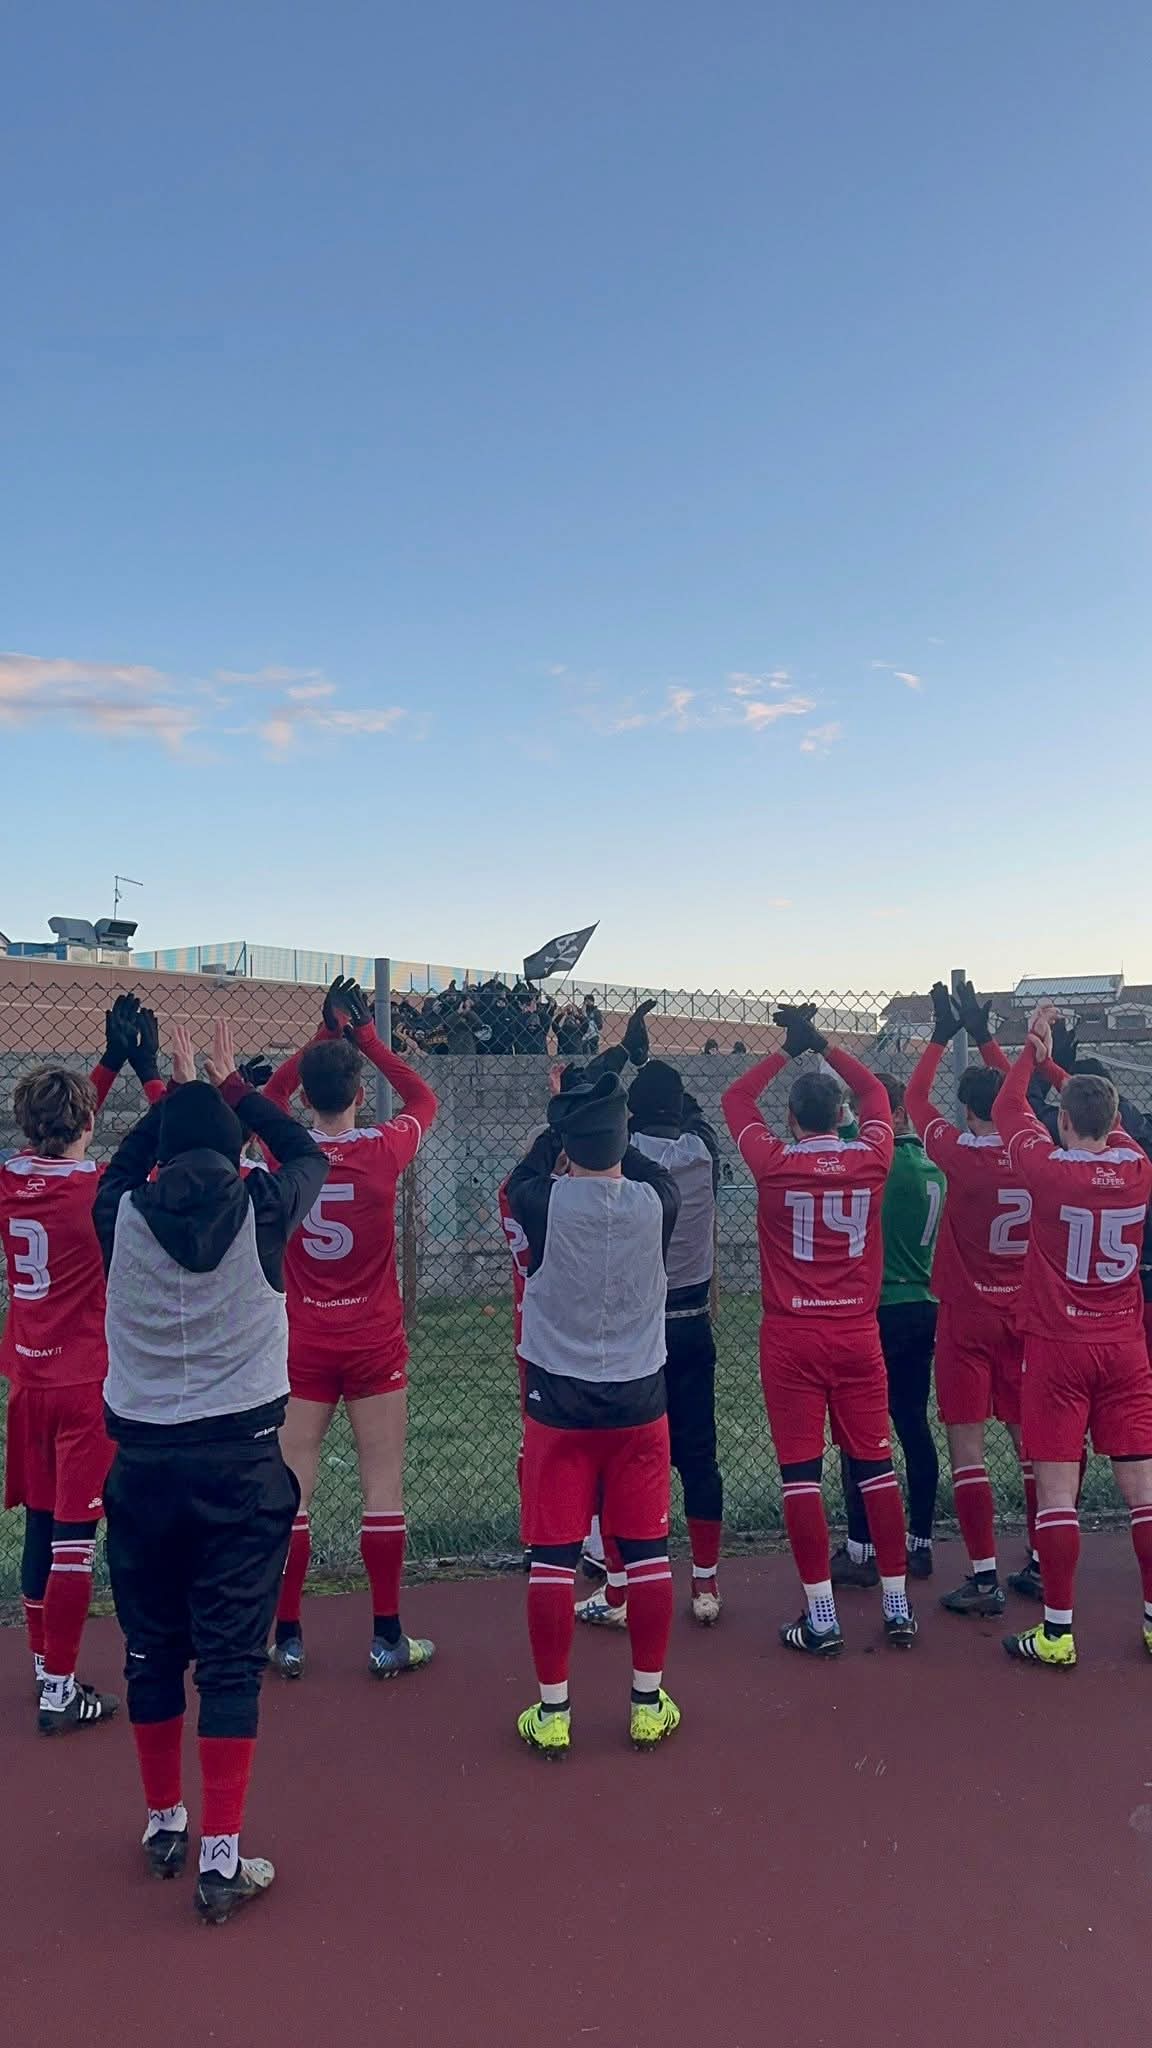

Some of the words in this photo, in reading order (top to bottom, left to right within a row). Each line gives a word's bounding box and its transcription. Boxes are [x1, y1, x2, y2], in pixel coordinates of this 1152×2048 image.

[302, 1184, 354, 1260] 5
[784, 1187, 871, 1261] 14
[920, 1181, 940, 1246] 1
[989, 1189, 1032, 1255] 2
[1060, 1204, 1146, 1283] 15
[9, 1218, 49, 1300] 3
